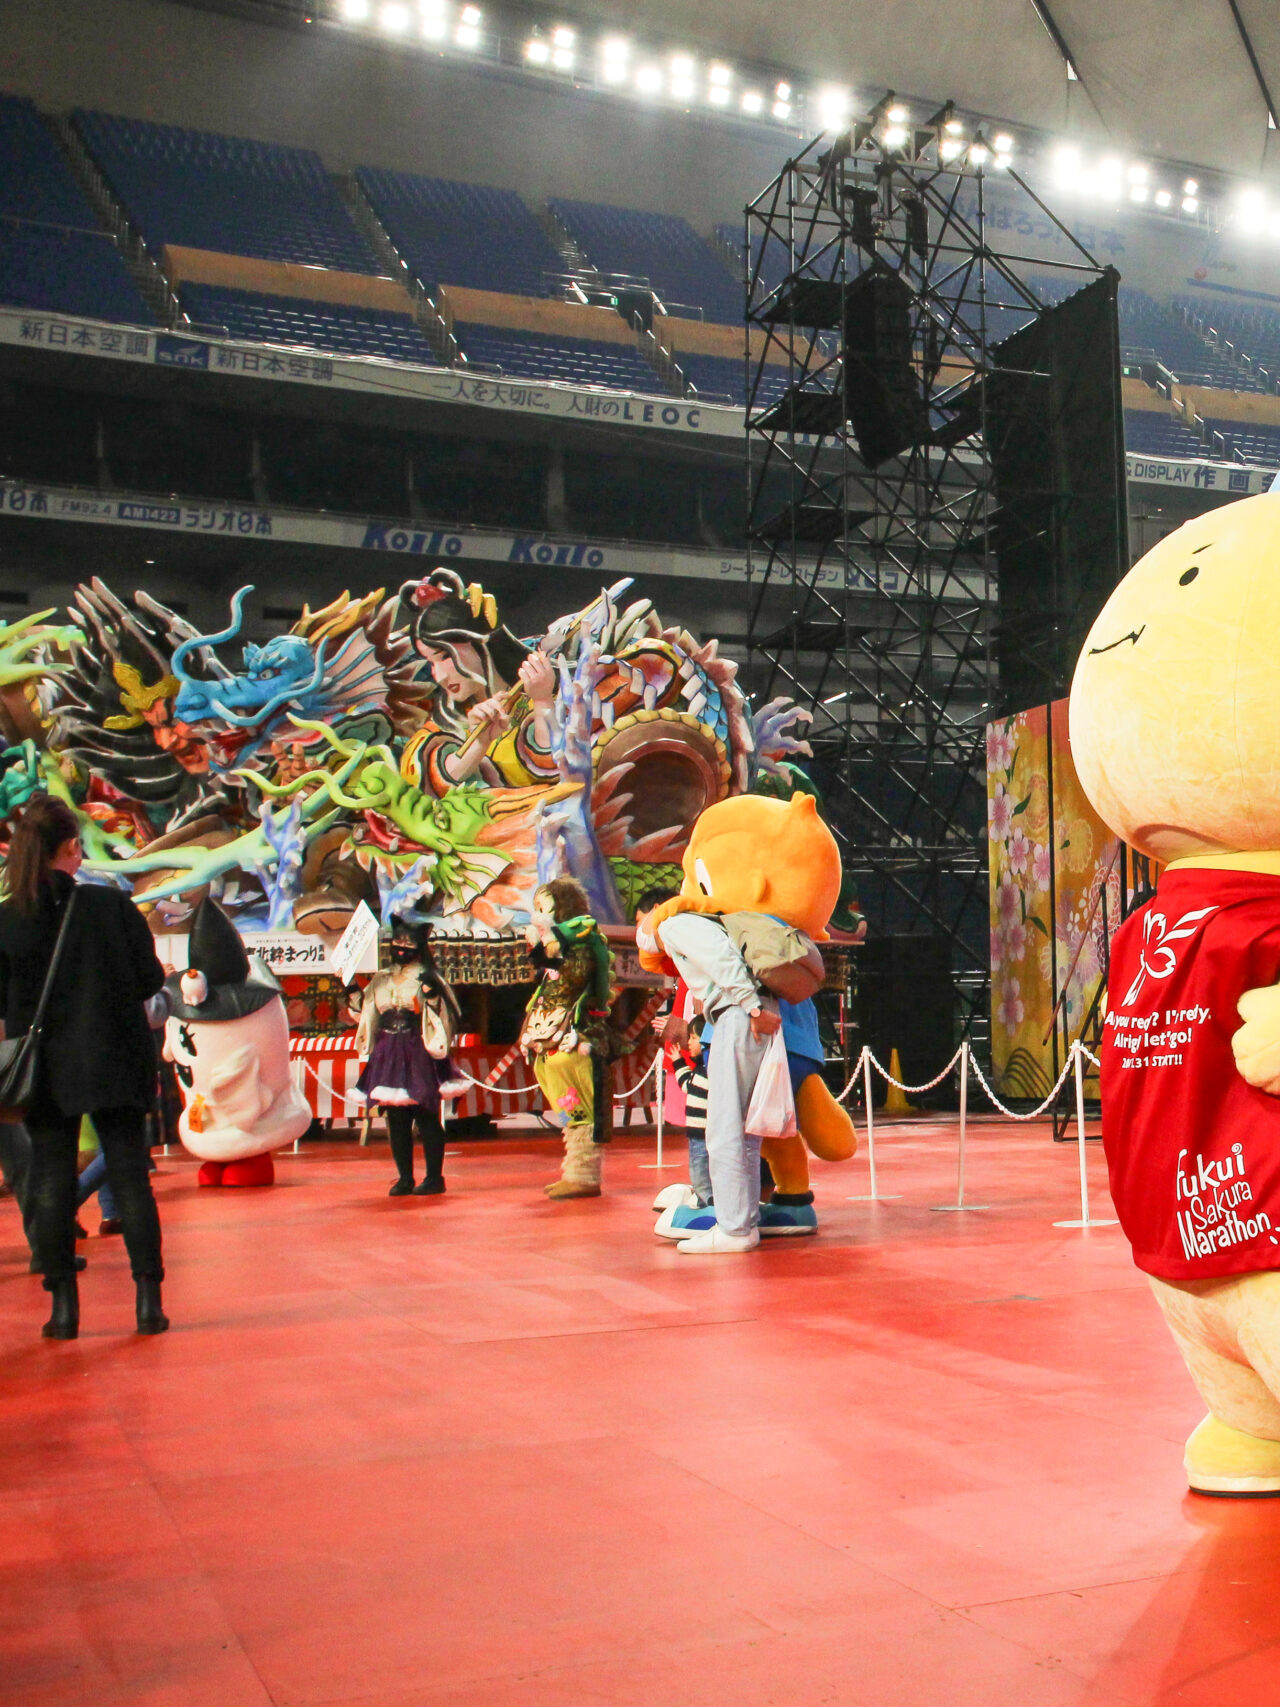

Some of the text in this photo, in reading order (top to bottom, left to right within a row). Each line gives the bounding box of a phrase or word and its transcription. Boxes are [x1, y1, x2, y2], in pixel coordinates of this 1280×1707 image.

[20, 319, 149, 357] 新日本空調
[214, 349, 333, 382] 新日本空調
[1135, 463, 1191, 482] DISPLAY
[1190, 1180, 1253, 1230] Sakura
[1176, 1209, 1272, 1261] Marathon
